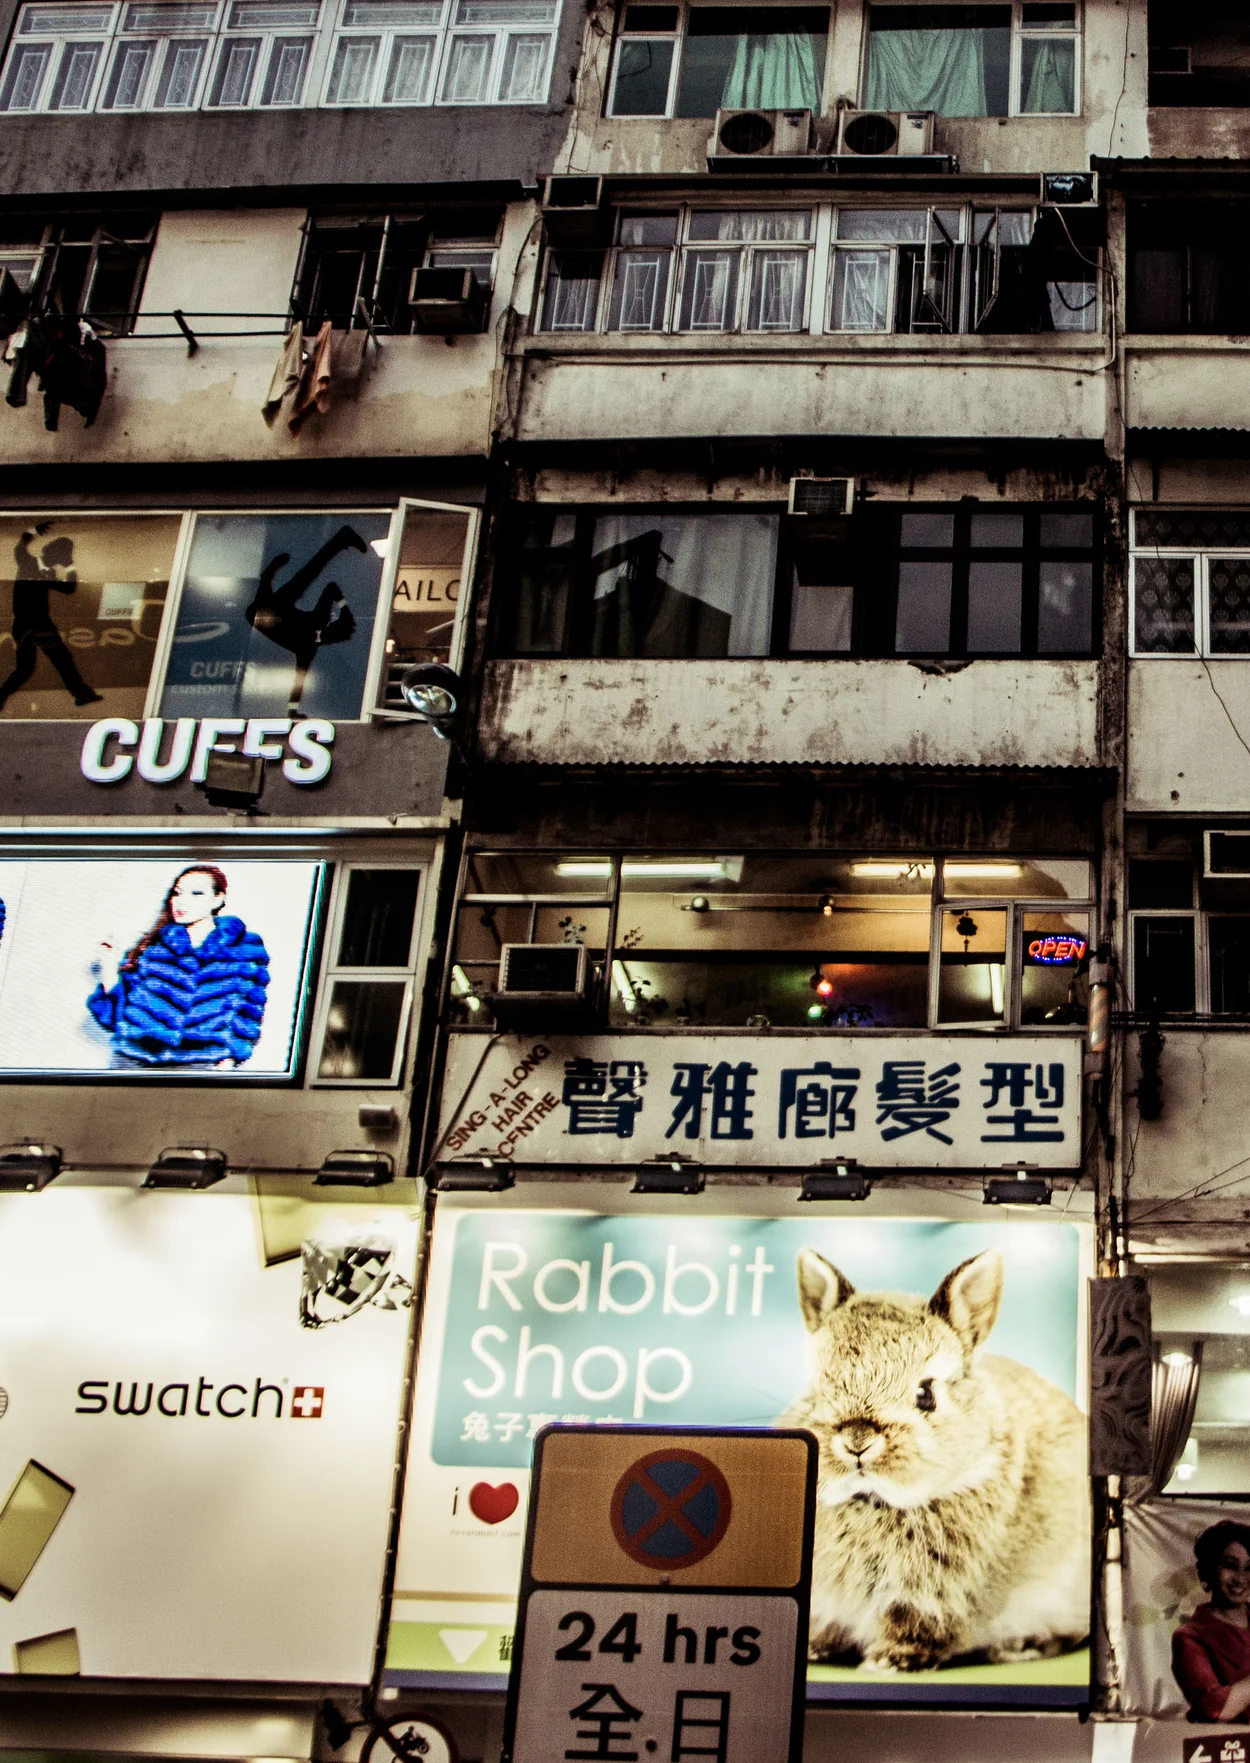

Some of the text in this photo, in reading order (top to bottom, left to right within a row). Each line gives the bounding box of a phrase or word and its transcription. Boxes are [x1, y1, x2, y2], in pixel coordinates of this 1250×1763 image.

[79, 718, 336, 783] CUFFS
[1028, 940, 1087, 960] OPEN
[491, 1090, 534, 1134] HAIR
[497, 1091, 561, 1160] CENTRE
[562, 1058, 1065, 1146] 聲雅廊髮型
[477, 1242, 775, 1317] Rabbit
[75, 1376, 285, 1418] swatch
[463, 1325, 694, 1420] Shop
[555, 1611, 641, 1664] 24
[662, 1613, 762, 1666] hrs
[563, 1683, 731, 1763] 全日
